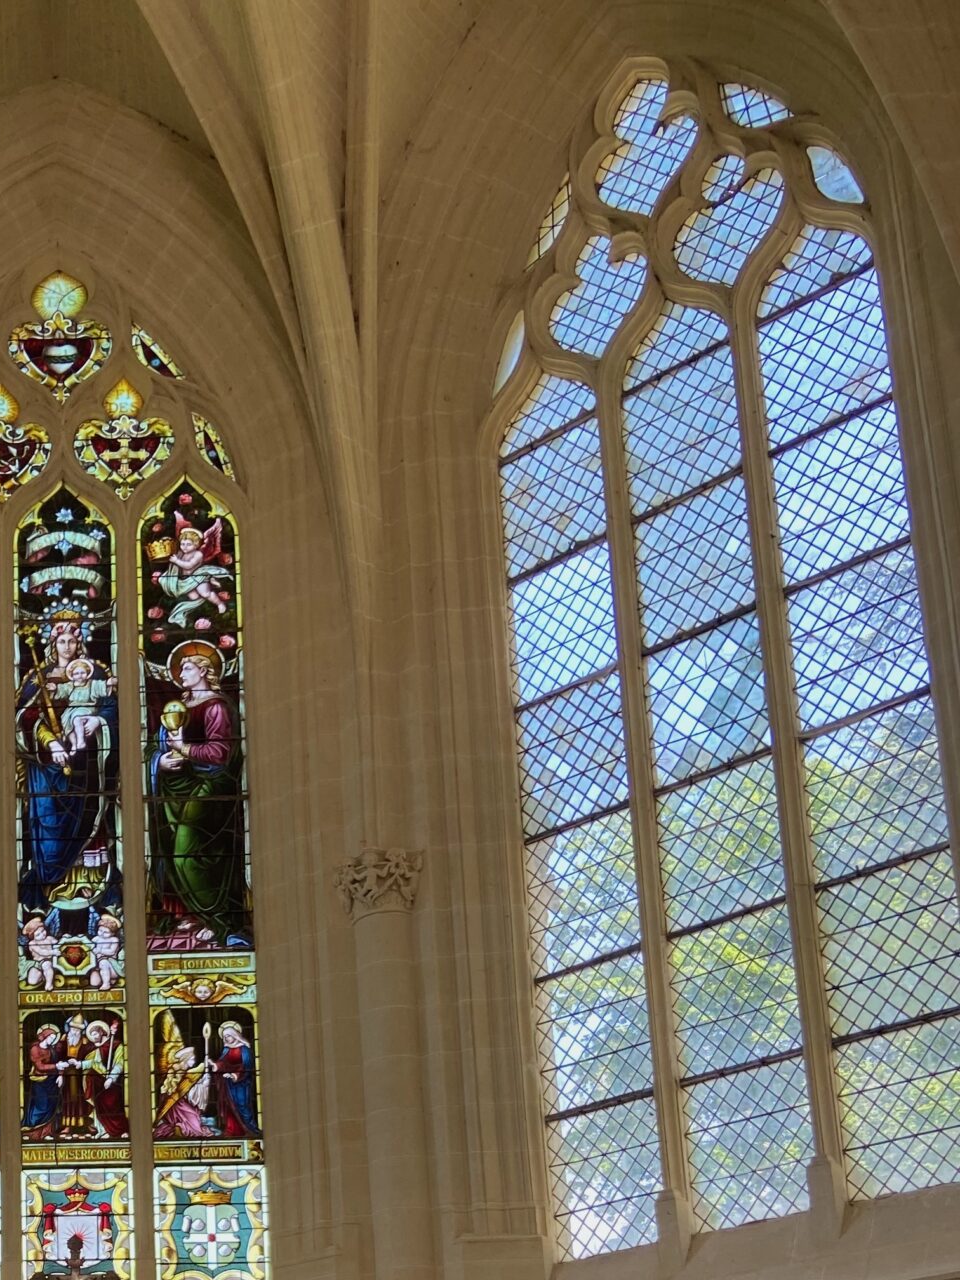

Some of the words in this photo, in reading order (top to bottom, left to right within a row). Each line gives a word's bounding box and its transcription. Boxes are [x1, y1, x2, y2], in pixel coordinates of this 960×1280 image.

[25, 993, 53, 1003] ORA
[57, 993, 82, 1003] PRO
[22, 1149, 55, 1161] MATER
